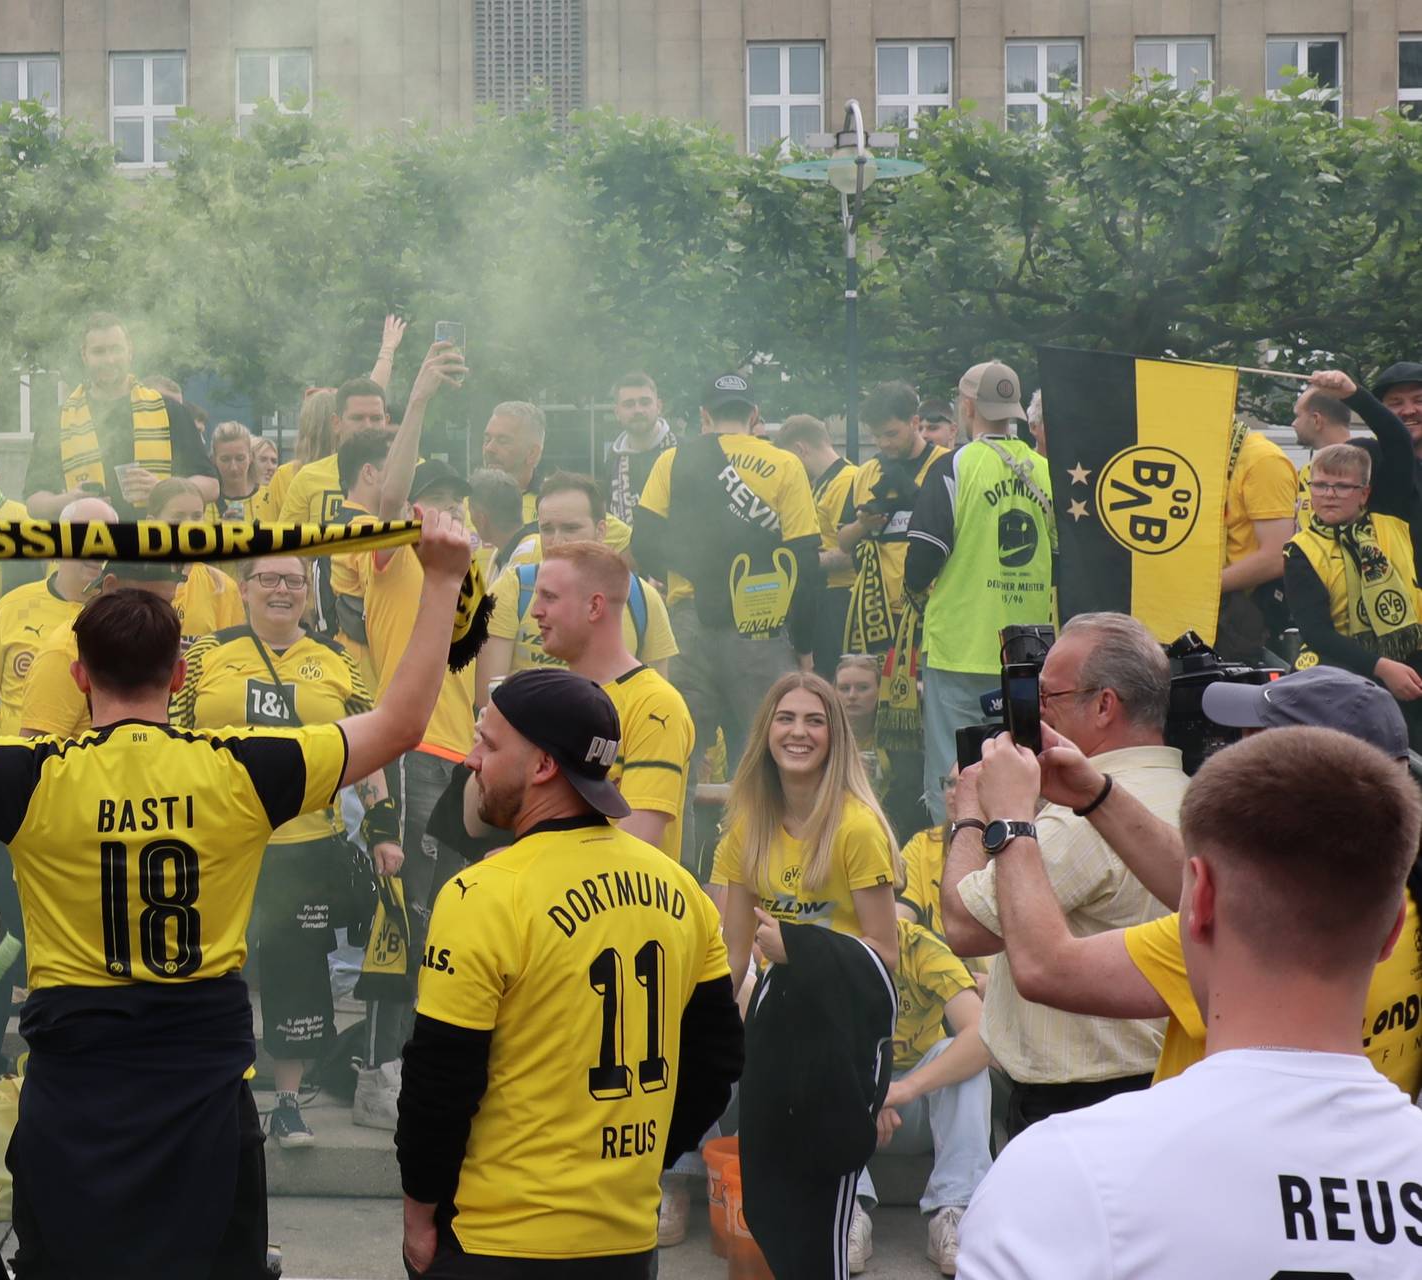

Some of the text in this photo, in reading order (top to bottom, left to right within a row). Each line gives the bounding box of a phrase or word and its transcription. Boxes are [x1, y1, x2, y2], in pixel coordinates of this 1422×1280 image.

[1379, 594, 1403, 617] BVB
[300, 664, 321, 680] BVB
[132, 732, 148, 742] BVB
[97, 795, 194, 833] BASTI
[100, 838, 203, 979] 18
[547, 870, 686, 938] DORTMUND
[588, 939, 669, 1101] 11
[601, 1119, 657, 1160] REUS
[1278, 1174, 1422, 1248] REUS
